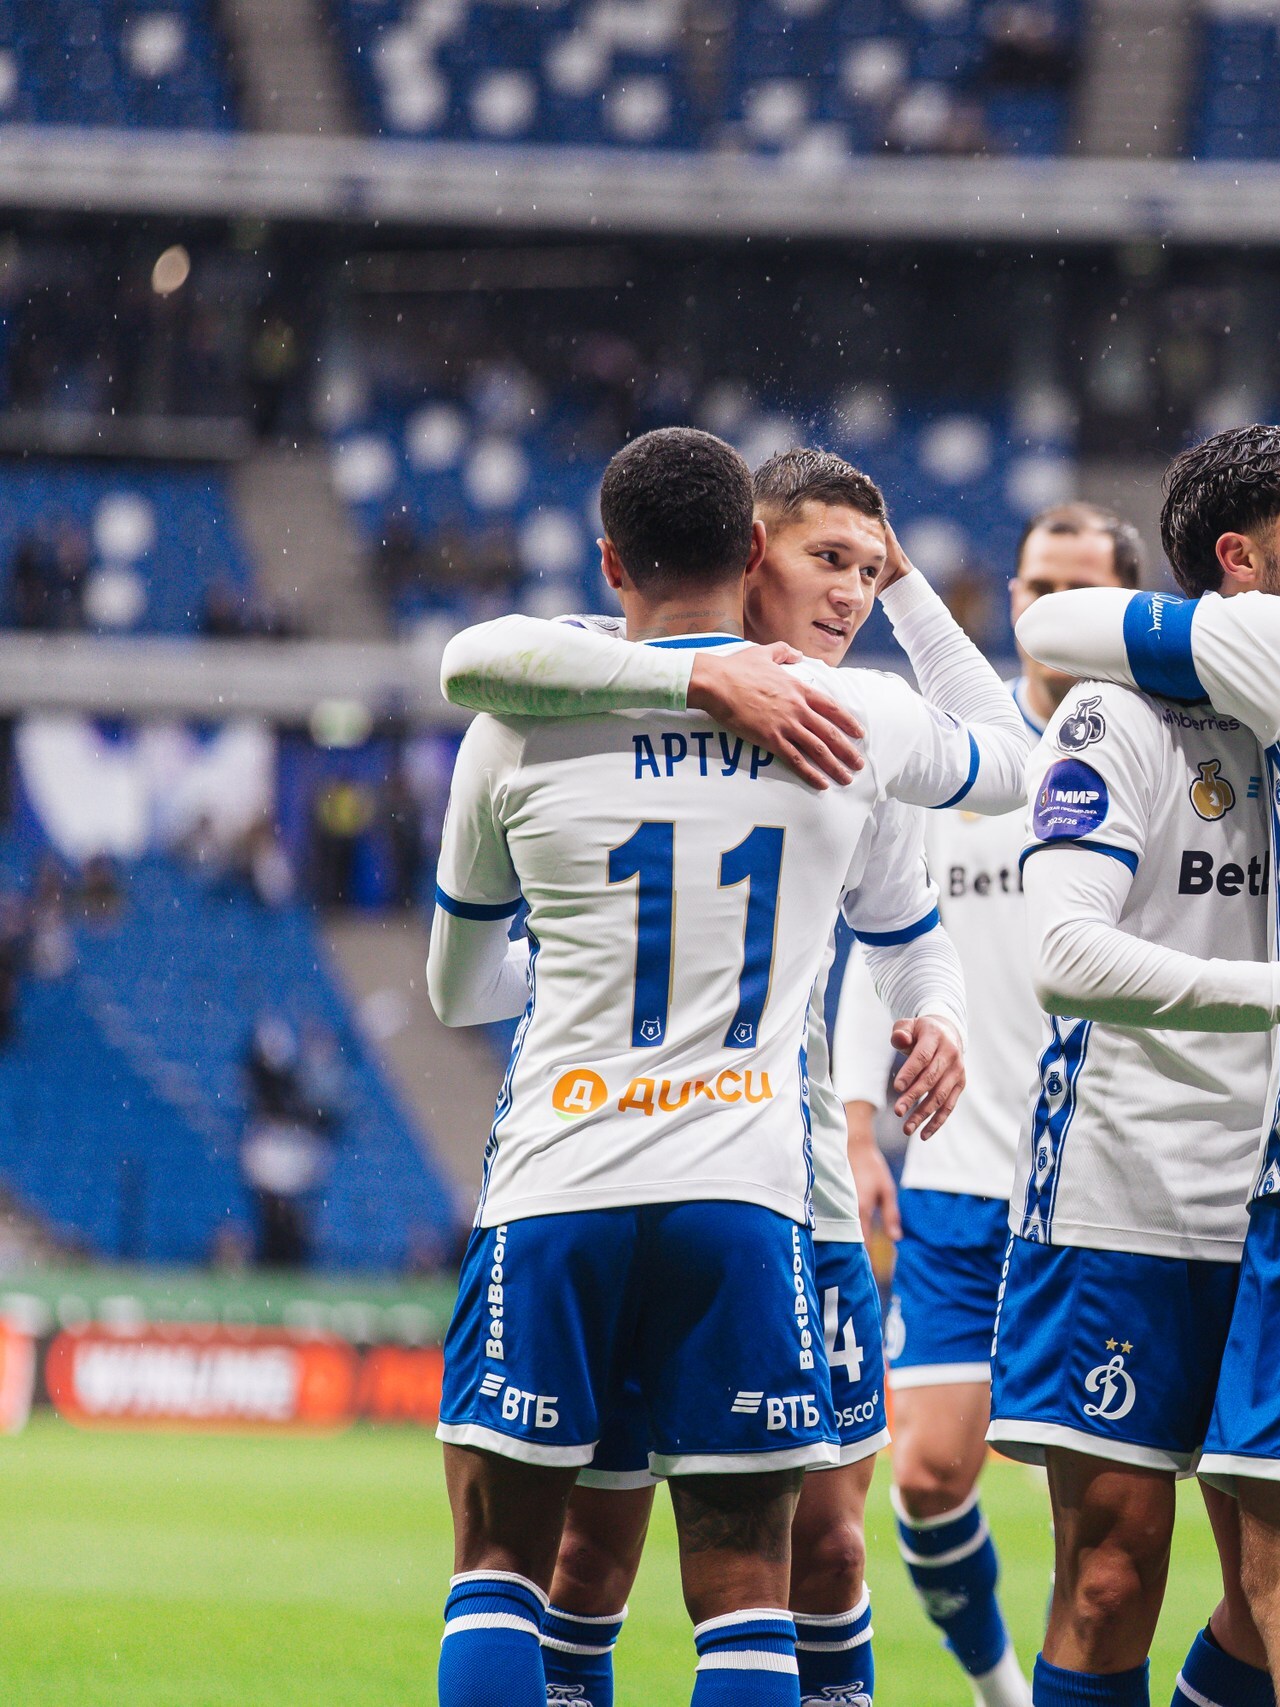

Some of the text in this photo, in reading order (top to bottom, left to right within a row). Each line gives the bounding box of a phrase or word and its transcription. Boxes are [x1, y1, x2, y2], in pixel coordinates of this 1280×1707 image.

[632, 731, 775, 780] АРТУР
[1055, 790, 1100, 804] МИР
[949, 866, 1024, 897] Bet
[1178, 850, 1270, 896] Bet
[605, 820, 784, 1050] 11
[792, 1225, 815, 1370] BetBoom
[823, 1286, 864, 1383] 4
[501, 1386, 560, 1429] ВТБ
[766, 1394, 820, 1431] ВТБ
